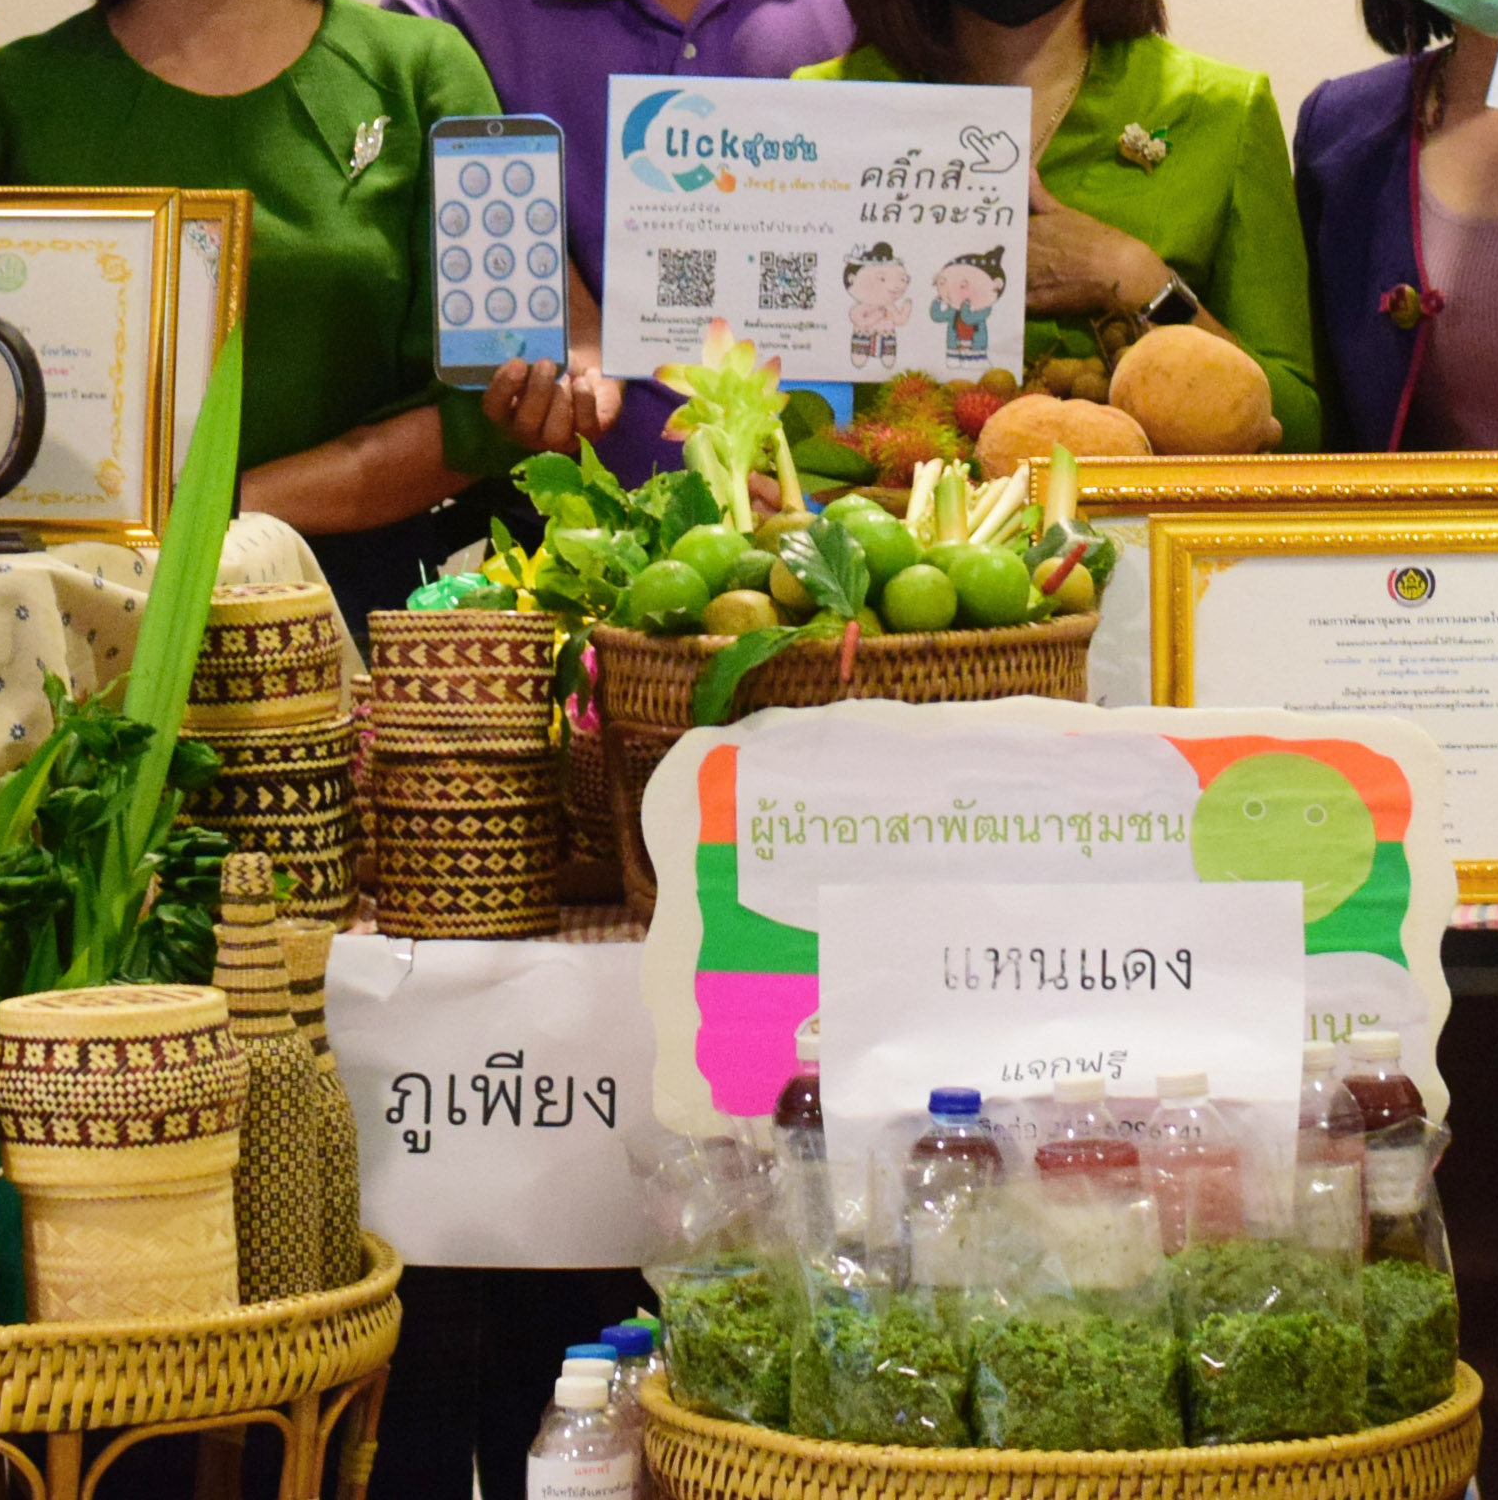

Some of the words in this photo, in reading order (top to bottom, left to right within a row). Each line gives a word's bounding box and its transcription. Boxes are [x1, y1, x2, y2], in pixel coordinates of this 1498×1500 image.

[859, 193, 1015, 228] แล้วจะรัก
[750, 795, 1187, 865] ผู้นำอาสาพัฒนาชุมชน
[943, 948, 1193, 993] แหนแดง
[1001, 1049, 1129, 1084] แจกฟรี
[385, 1050, 618, 1154] ภูเพียง
